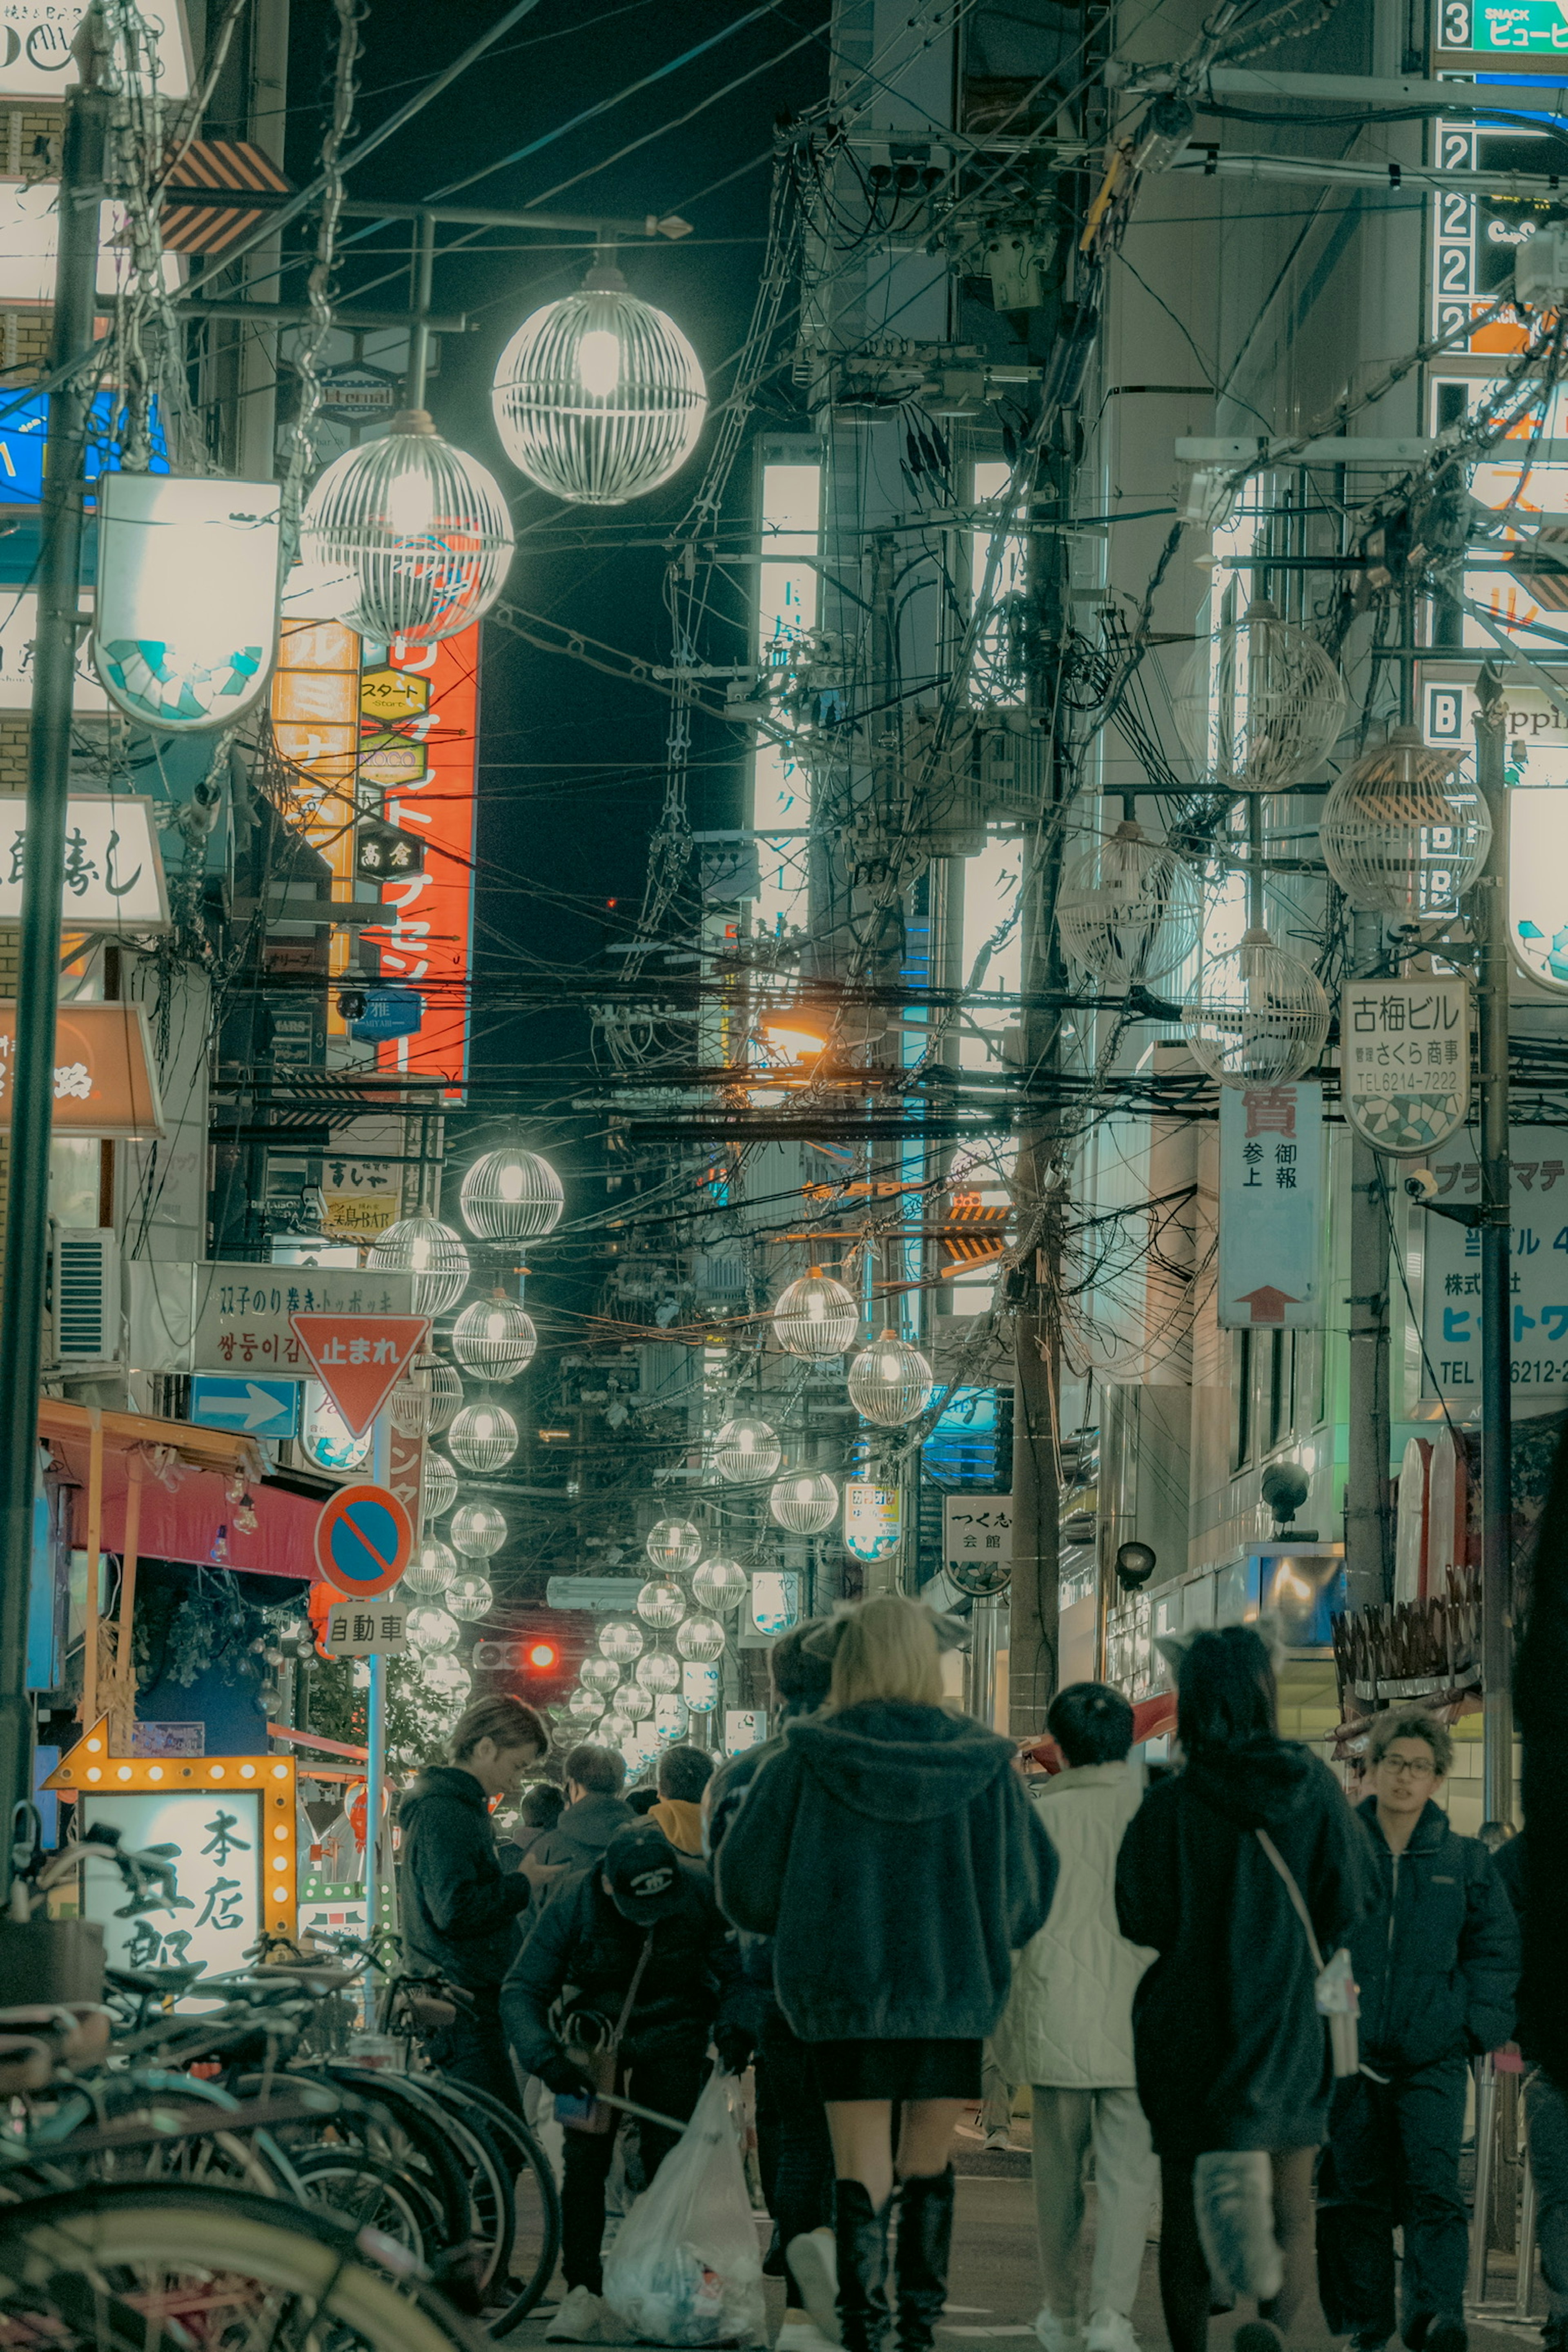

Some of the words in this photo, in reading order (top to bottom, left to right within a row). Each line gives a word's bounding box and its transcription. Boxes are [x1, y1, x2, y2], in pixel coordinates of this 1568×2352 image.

[1446, 2, 1469, 43] 3
[1485, 8, 1530, 21] SNACK
[1444, 193, 1466, 234] 2
[1443, 249, 1466, 290] 2
[1442, 306, 1465, 348] 2
[362, 684, 418, 698] スタート
[1435, 695, 1456, 733] B
[361, 842, 411, 867] 高倉
[370, 998, 390, 1018] 雅
[1352, 996, 1459, 1032] 古梅ビル
[316, 1032, 324, 1048] 3
[1376, 1040, 1458, 1065] さくら商事
[1357, 1071, 1457, 1091] TEL6214-7222
[1242, 1087, 1298, 1138] 質
[1243, 1142, 1265, 1187] 参上
[1275, 1143, 1297, 1189] 御報
[1436, 1160, 1565, 1194] プラマテ
[1443, 1304, 1568, 1343] ヒトワ
[218, 1332, 300, 1363] 쌍둥이김
[319, 1336, 400, 1365] 止まれ
[1441, 1361, 1474, 1384] TEL
[951, 1512, 1013, 1528] つく志
[963, 1535, 1000, 1548] 会館
[331, 1615, 402, 1641] 自動車
[194, 1809, 251, 1930] 本店
